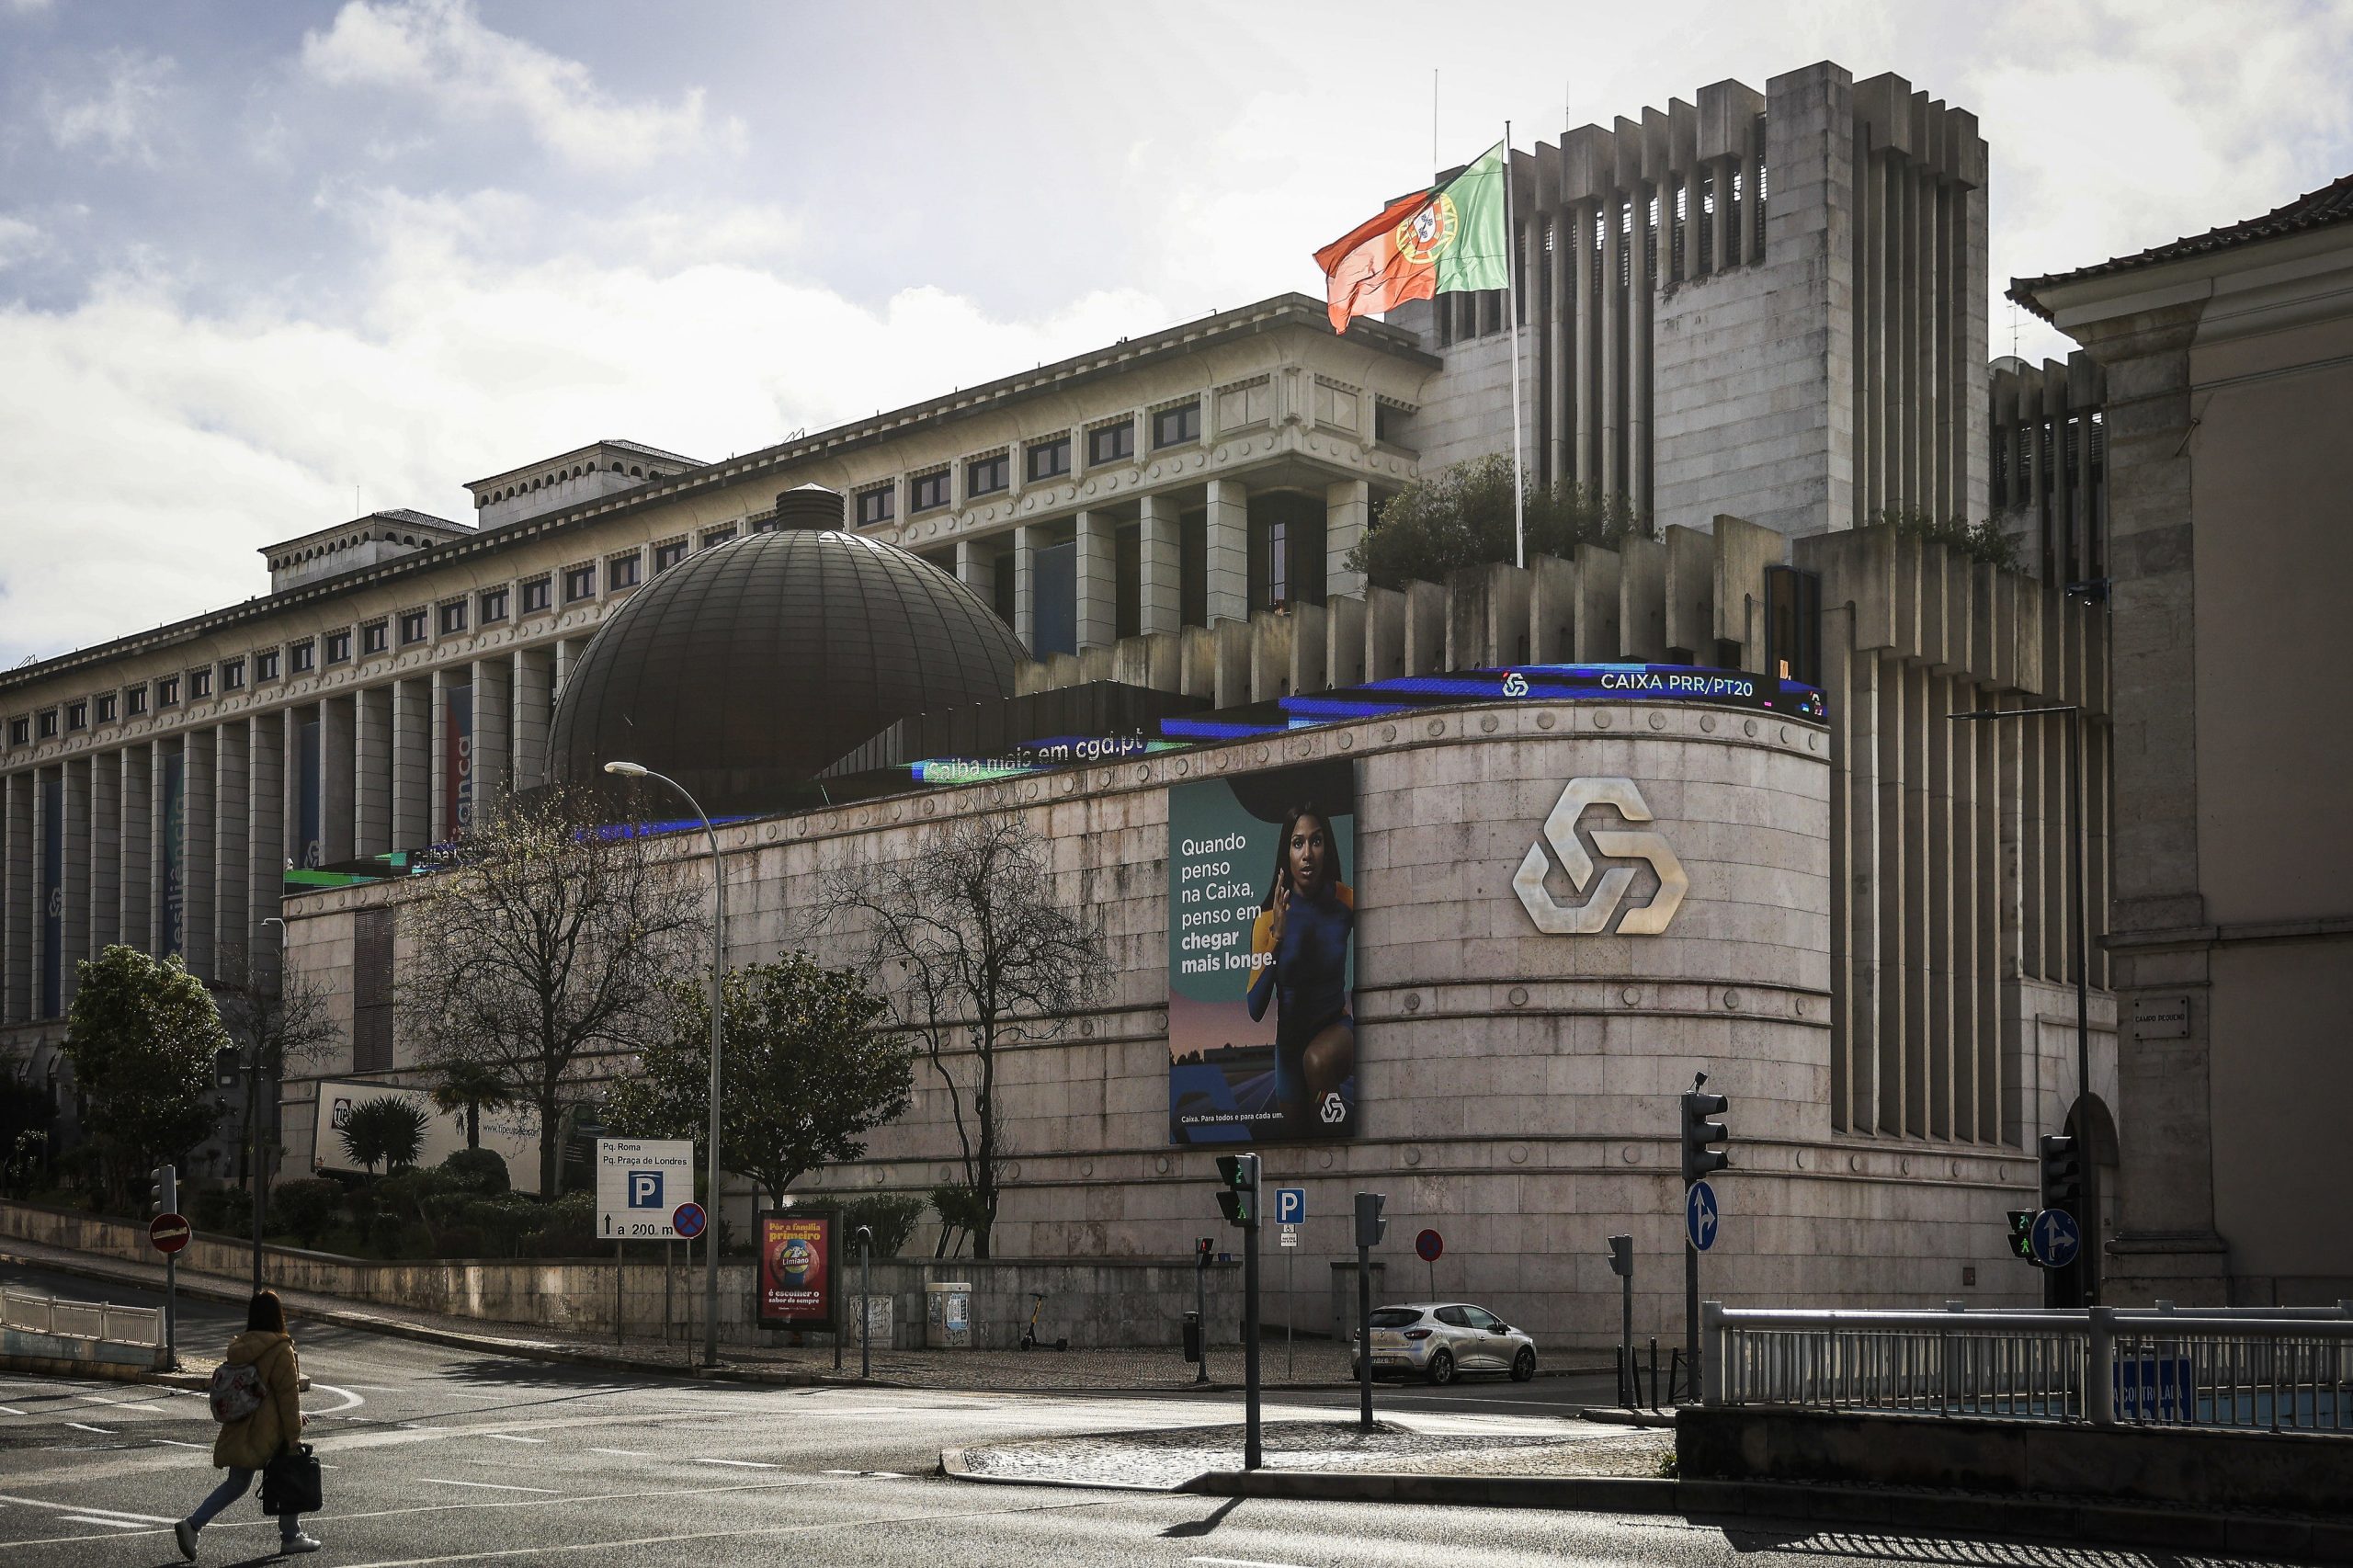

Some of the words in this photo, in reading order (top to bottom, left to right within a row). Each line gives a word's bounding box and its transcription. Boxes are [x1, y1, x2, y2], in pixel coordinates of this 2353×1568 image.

[1600, 674, 1663, 690] CAIXA
[1669, 676, 1753, 697] PRR/PT20
[927, 757, 980, 782] Saiba
[986, 747, 1031, 773] mais
[1038, 744, 1069, 765] em
[1075, 728, 1143, 761] cgd.pt
[1181, 832, 1246, 856] Quando
[1182, 861, 1231, 882] penso
[1182, 888, 1200, 903] na
[1206, 881, 1254, 901] Caixa,
[1182, 908, 1231, 930] penso
[1236, 904, 1262, 920] em
[1181, 931, 1239, 950] chegar
[1181, 954, 1221, 973] mais
[1225, 951, 1277, 970] longe.
[2135, 1015, 2156, 1023] CAMPO
[2158, 1014, 2185, 1022] PEQUENO
[1181, 1115, 1199, 1123] Caixa.
[1256, 1111, 1271, 1119] cada
[603, 1142, 616, 1152] Pq.
[603, 1155, 616, 1165] Pq.
[618, 1156, 641, 1165] Praça
[642, 1156, 653, 1165] de
[655, 1156, 687, 1165] Londres
[635, 1177, 655, 1205] P
[1281, 1192, 1298, 1221] P
[618, 1226, 625, 1235] a
[632, 1224, 655, 1235] 200
[662, 1226, 673, 1235] m
[769, 1231, 821, 1242] primeiro
[782, 1257, 809, 1266] Limiano
[768, 1289, 774, 1297] é
